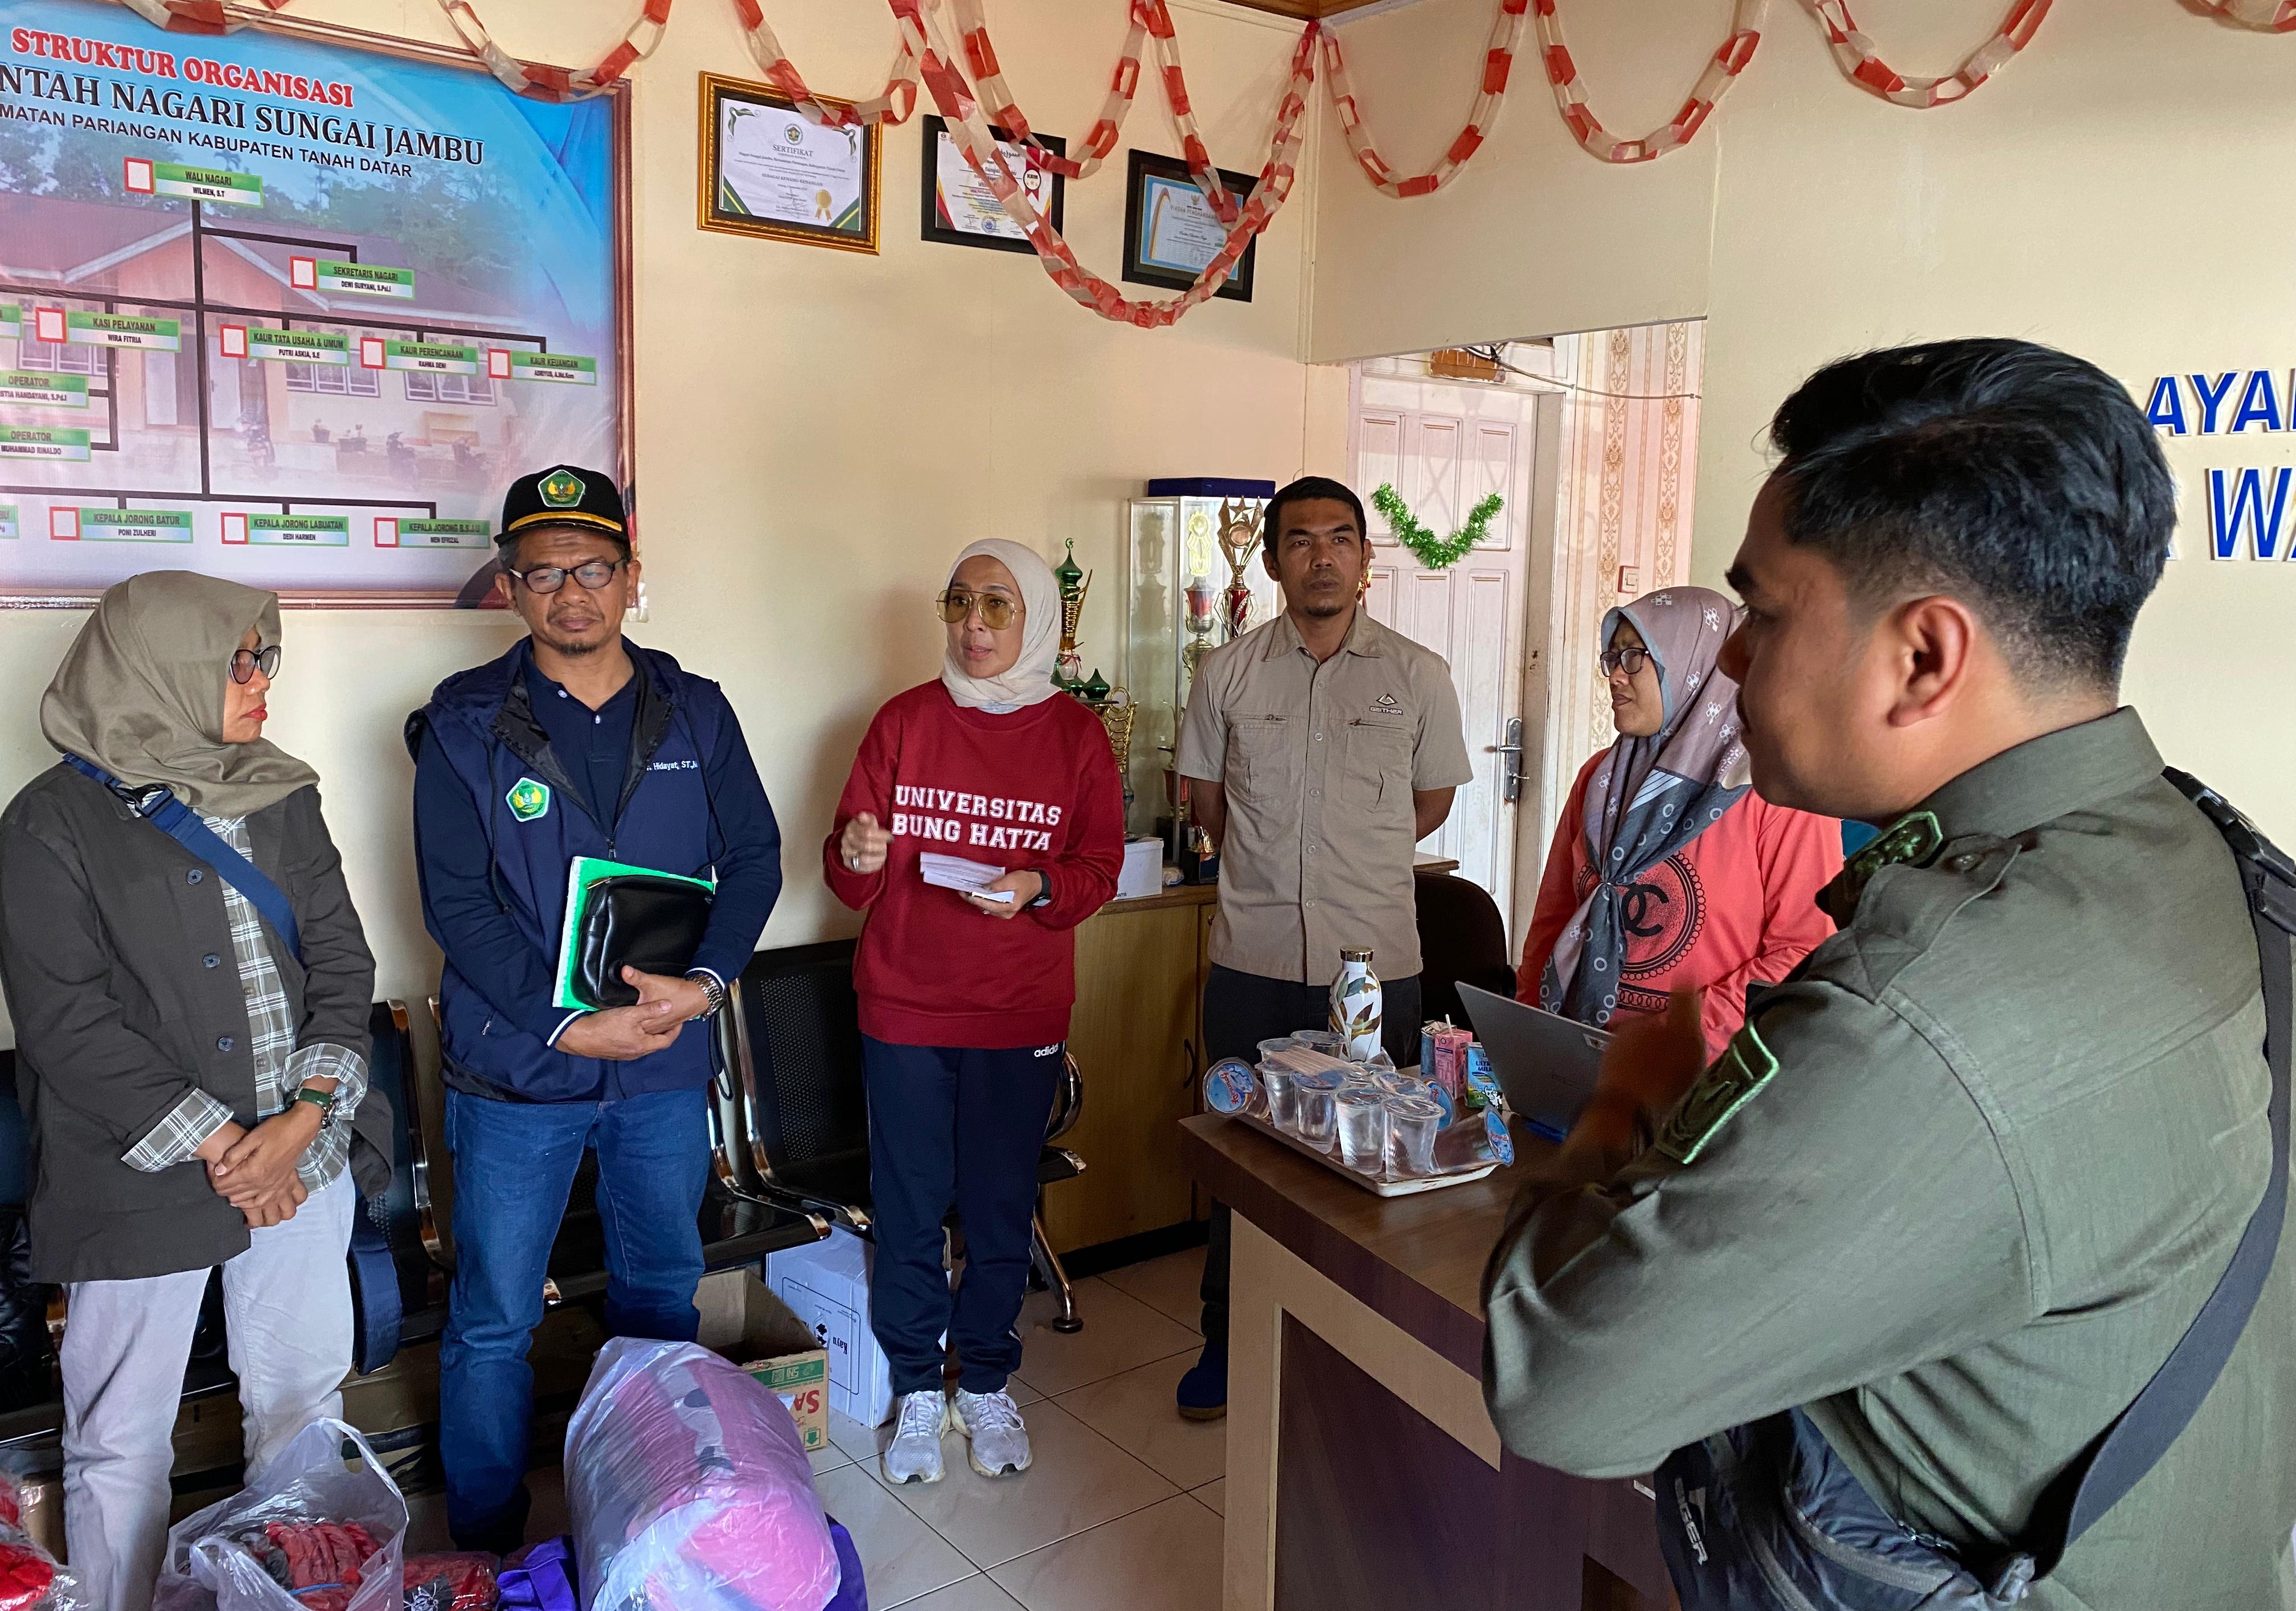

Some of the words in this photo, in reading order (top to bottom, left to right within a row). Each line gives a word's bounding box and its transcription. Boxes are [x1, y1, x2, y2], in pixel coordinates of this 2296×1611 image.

[12, 28, 177, 79] STRUKTUR
[183, 58, 354, 108] ORGANISASI
[110, 81, 246, 129] NAGARI
[255, 104, 376, 149] SUNGAI
[384, 126, 484, 165] JAMBU
[72, 113, 182, 144] PARIANGAN
[188, 132, 293, 160] KABUPATEN
[299, 149, 354, 169] TANAH
[360, 158, 412, 178] DATAR
[773, 144, 813, 157] SERTIFIKAT
[186, 171, 203, 182] WALI
[206, 173, 232, 186] NAGARI
[192, 187, 215, 198] WILMEN,
[334, 267, 373, 278] SEKRETARIS
[375, 271, 398, 281] NAGARI
[93, 317, 110, 329] KASI
[113, 319, 155, 332] PELAYANAN
[254, 332, 272, 343] KAUR
[274, 334, 290, 345] TATA
[292, 336, 314, 347] USAHA
[317, 338, 322, 347] &
[323, 339, 343, 349] UMUM
[400, 346, 417, 355] KAUR
[419, 347, 464, 358] PERENCANAAN
[9, 375, 50, 387] OPERATOR
[2146, 368, 2296, 436] AYA
[11, 431, 52, 441] OPERATOR
[93, 513, 122, 524] KEPALA
[124, 514, 154, 524] JORONG
[156, 515, 180, 525] BATUR
[2209, 466, 2296, 561] W
[254, 519, 280, 527] KEPALA
[281, 520, 309, 528] JORONG
[310, 520, 343, 530] LABUATAN
[433, 523, 458, 532] JORONG
[653, 762, 679, 771] Hidayat,
[895, 785, 1062, 826] UNIVERSITAS
[892, 813, 961, 843] BUNG
[969, 822, 1052, 851] HATTA
[833, 1336, 848, 1355] Kayu
